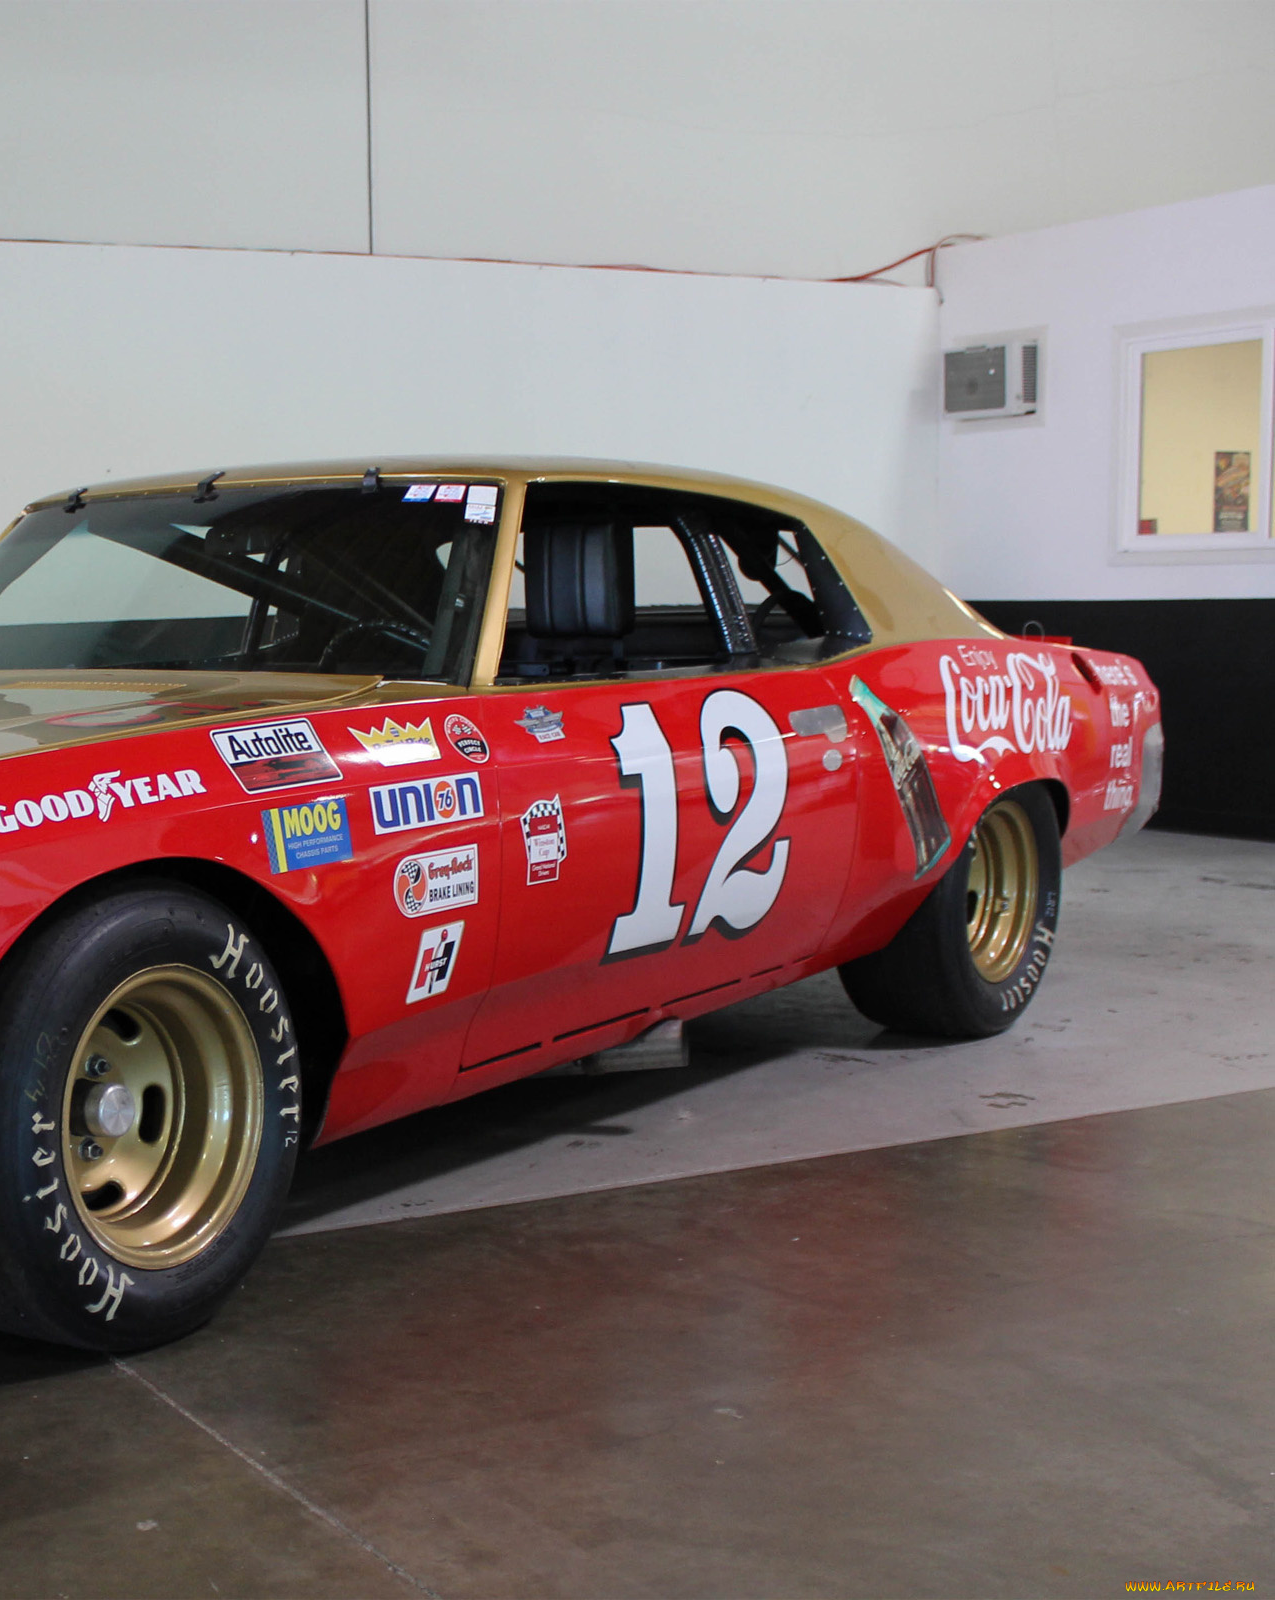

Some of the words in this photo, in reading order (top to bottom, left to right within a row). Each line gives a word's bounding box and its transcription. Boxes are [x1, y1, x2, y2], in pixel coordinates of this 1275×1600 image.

[957, 645, 998, 670] Enjoy
[939, 652, 1073, 762] Coca-Cola
[1109, 693, 1130, 727] the
[227, 728, 313, 761] Autolite
[457, 739, 480, 748] PERFECT
[464, 746, 482, 754] CIRCLE
[1109, 736, 1133, 768] real
[372, 777, 481, 829] UNION
[436, 787, 454, 811] 76
[282, 801, 341, 838] MOOG
[601, 688, 791, 964] 12
[288, 841, 302, 850] HIGH
[302, 833, 344, 848] PERFORMANCE
[295, 848, 320, 859] CHASSIS
[320, 845, 339, 855] PARTS
[429, 885, 451, 902] BRAKE
[452, 881, 474, 898] LINING
[424, 957, 448, 972] HURST
[209, 923, 299, 1123] Hoosier
[285, 1130, 298, 1148] 12
[23, 1111, 136, 1322] Hoosier
